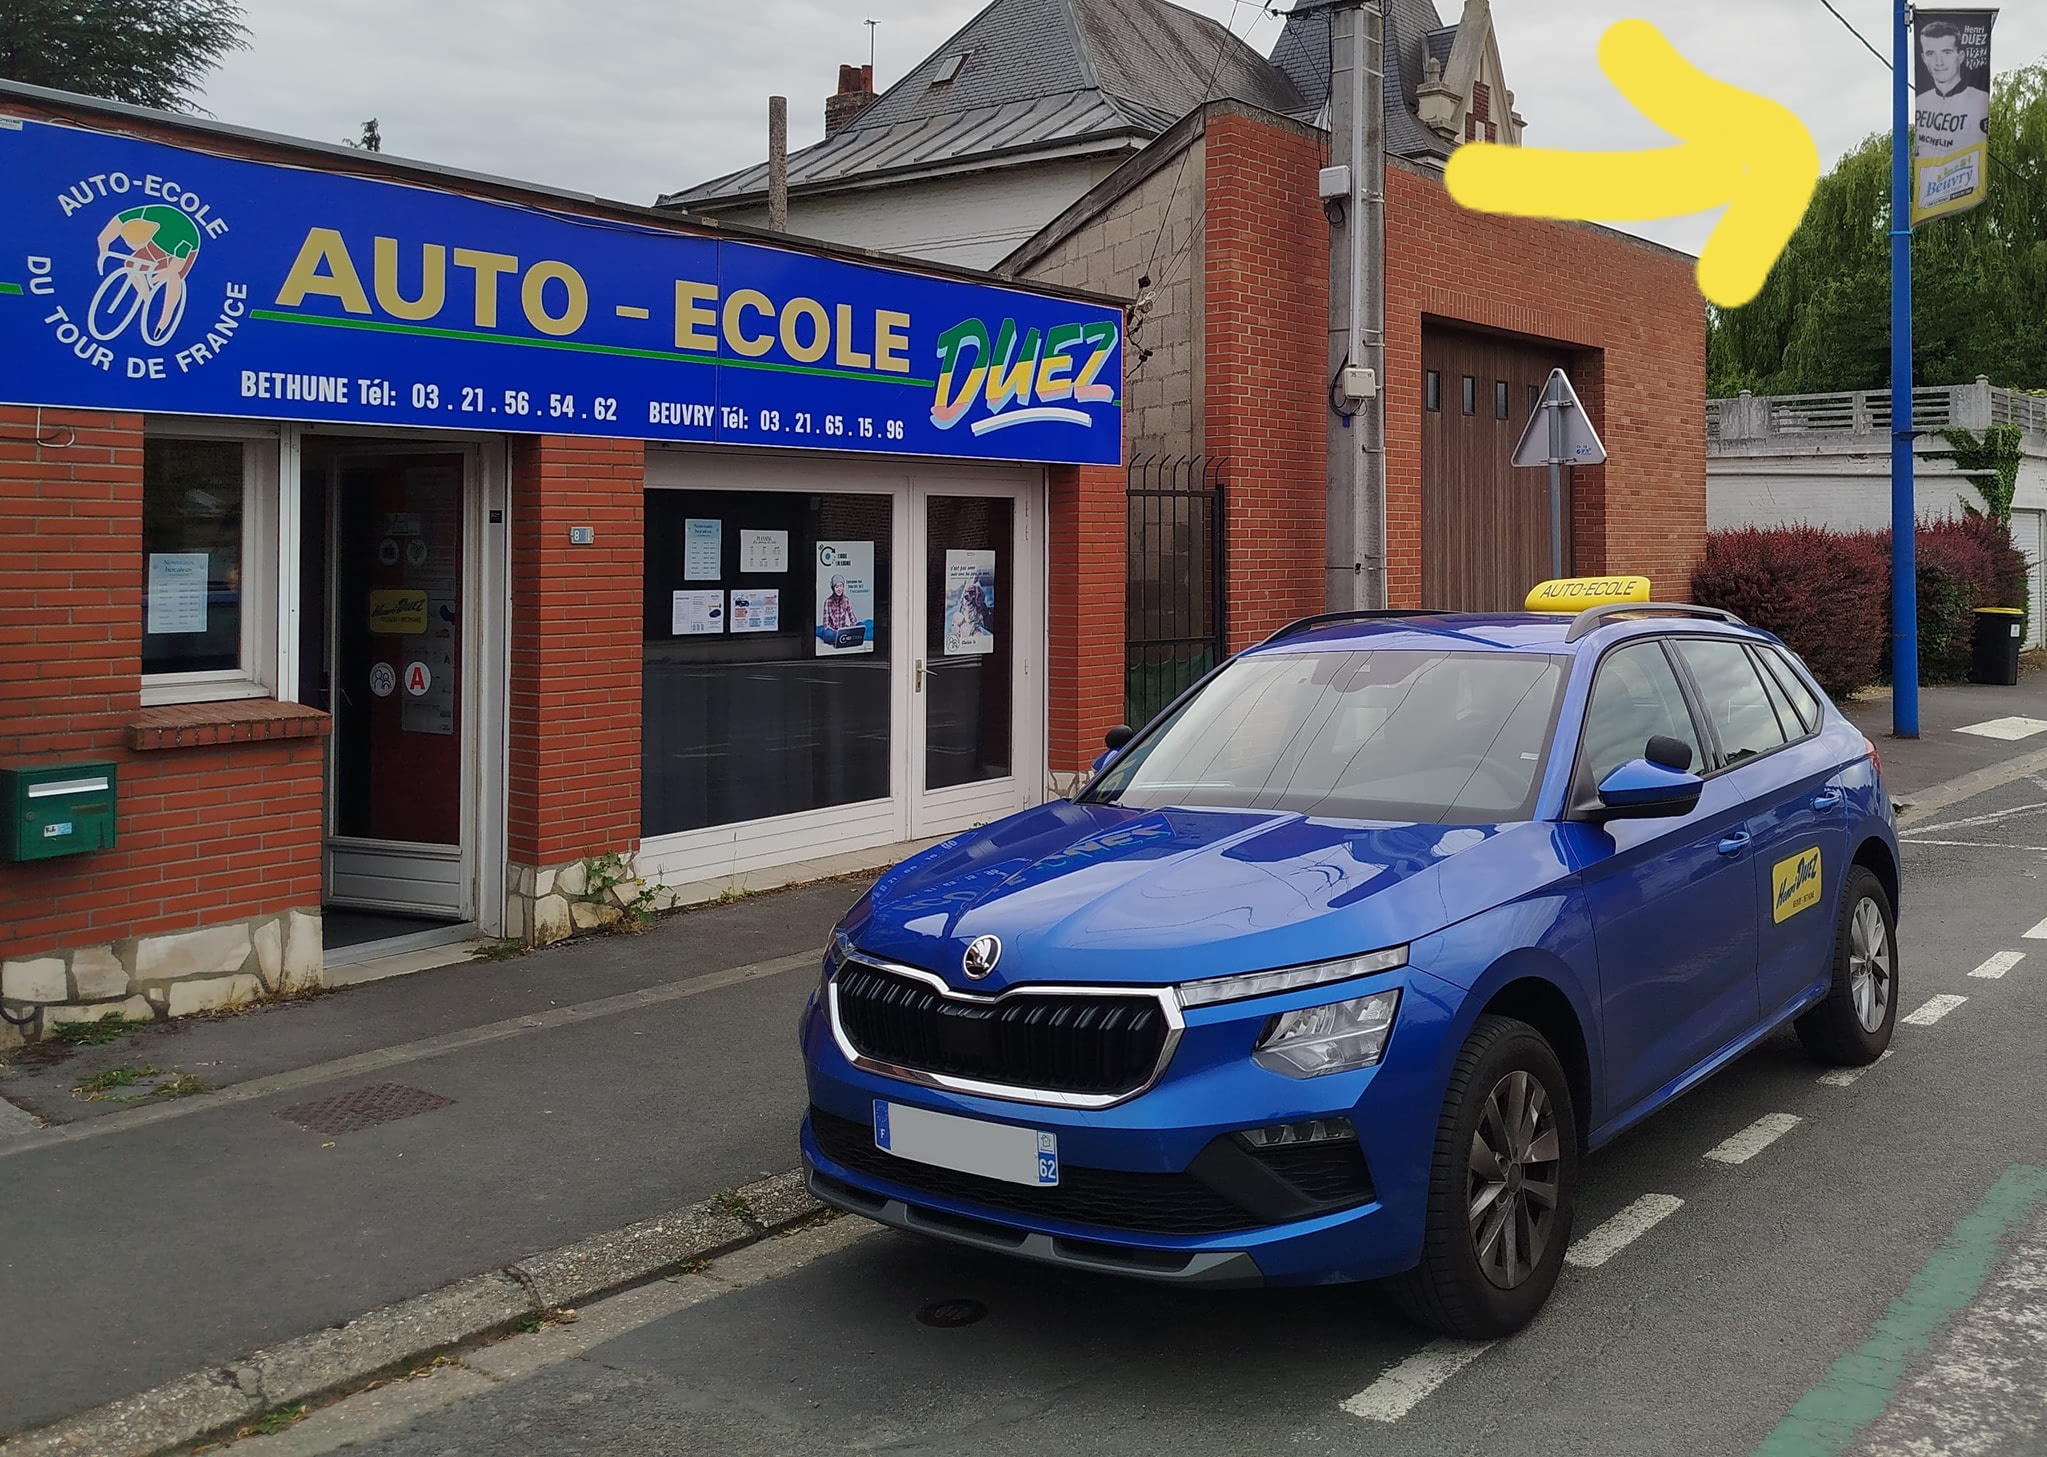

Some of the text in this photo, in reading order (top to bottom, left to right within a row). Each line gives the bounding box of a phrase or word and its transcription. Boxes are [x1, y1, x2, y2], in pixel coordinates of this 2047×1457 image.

[1961, 33, 1987, 45] DUEZ
[1964, 25, 1985, 34] Henri
[1915, 110, 1968, 132] PEUGEOT
[1919, 134, 1953, 148] MICHELIN
[1926, 169, 1973, 197] Beuvry
[57, 172, 229, 239] AUTO-ECOLE
[275, 226, 588, 335] AUTO
[674, 279, 910, 373] ECOLE
[27, 256, 247, 379] DU TOUR DE FRANCE
[930, 317, 1118, 430] DUEZ
[241, 370, 348, 404] BETHUNE
[358, 378, 396, 406] Tél:
[411, 383, 439, 409] 03
[461, 387, 483, 412] 21
[504, 390, 529, 415] 56
[550, 393, 574, 418] 54
[594, 397, 617, 421] 62
[649, 401, 715, 427] BEUVRY
[721, 406, 749, 429] Tél:
[760, 409, 780, 432] 03
[795, 412, 811, 434] 21
[825, 415, 843, 435] 65
[857, 417, 873, 438] 15
[886, 420, 904, 440] 96
[1540, 581, 1637, 599] AUTO-ECOLE
[410, 666, 426, 690] A
[880, 1128, 886, 1139] F
[1039, 1158, 1057, 1179] 62
